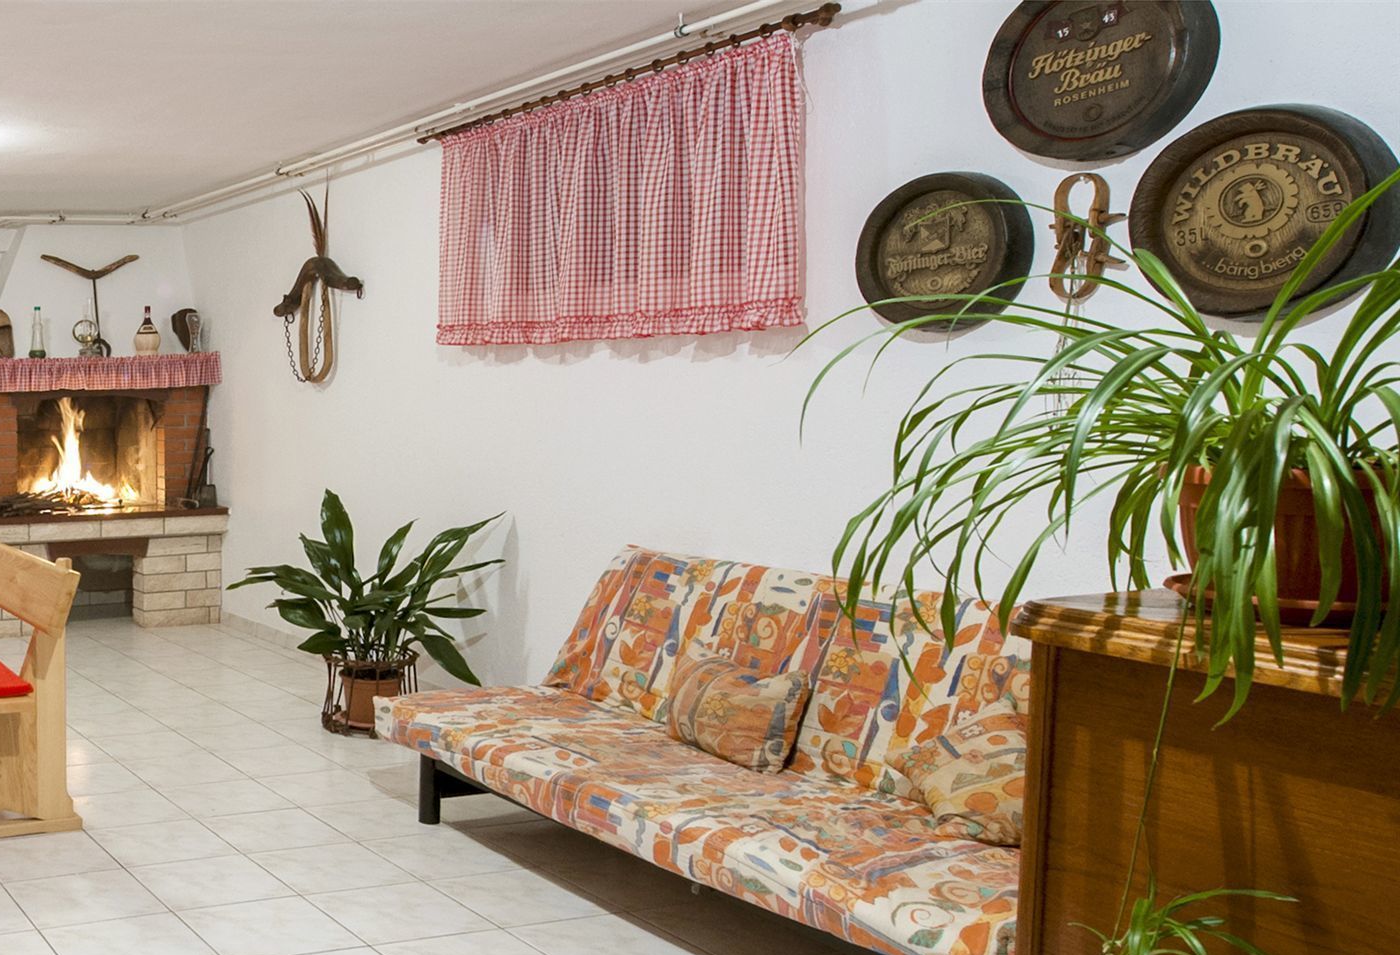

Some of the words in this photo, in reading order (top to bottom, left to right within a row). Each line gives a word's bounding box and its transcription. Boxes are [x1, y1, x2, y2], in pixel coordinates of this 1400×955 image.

[1056, 27, 1070, 39] 15
[1053, 62, 1123, 95] Bräu
[1053, 79, 1130, 107] ROSENHEIM
[1171, 142, 1344, 226] WILDBRÄU
